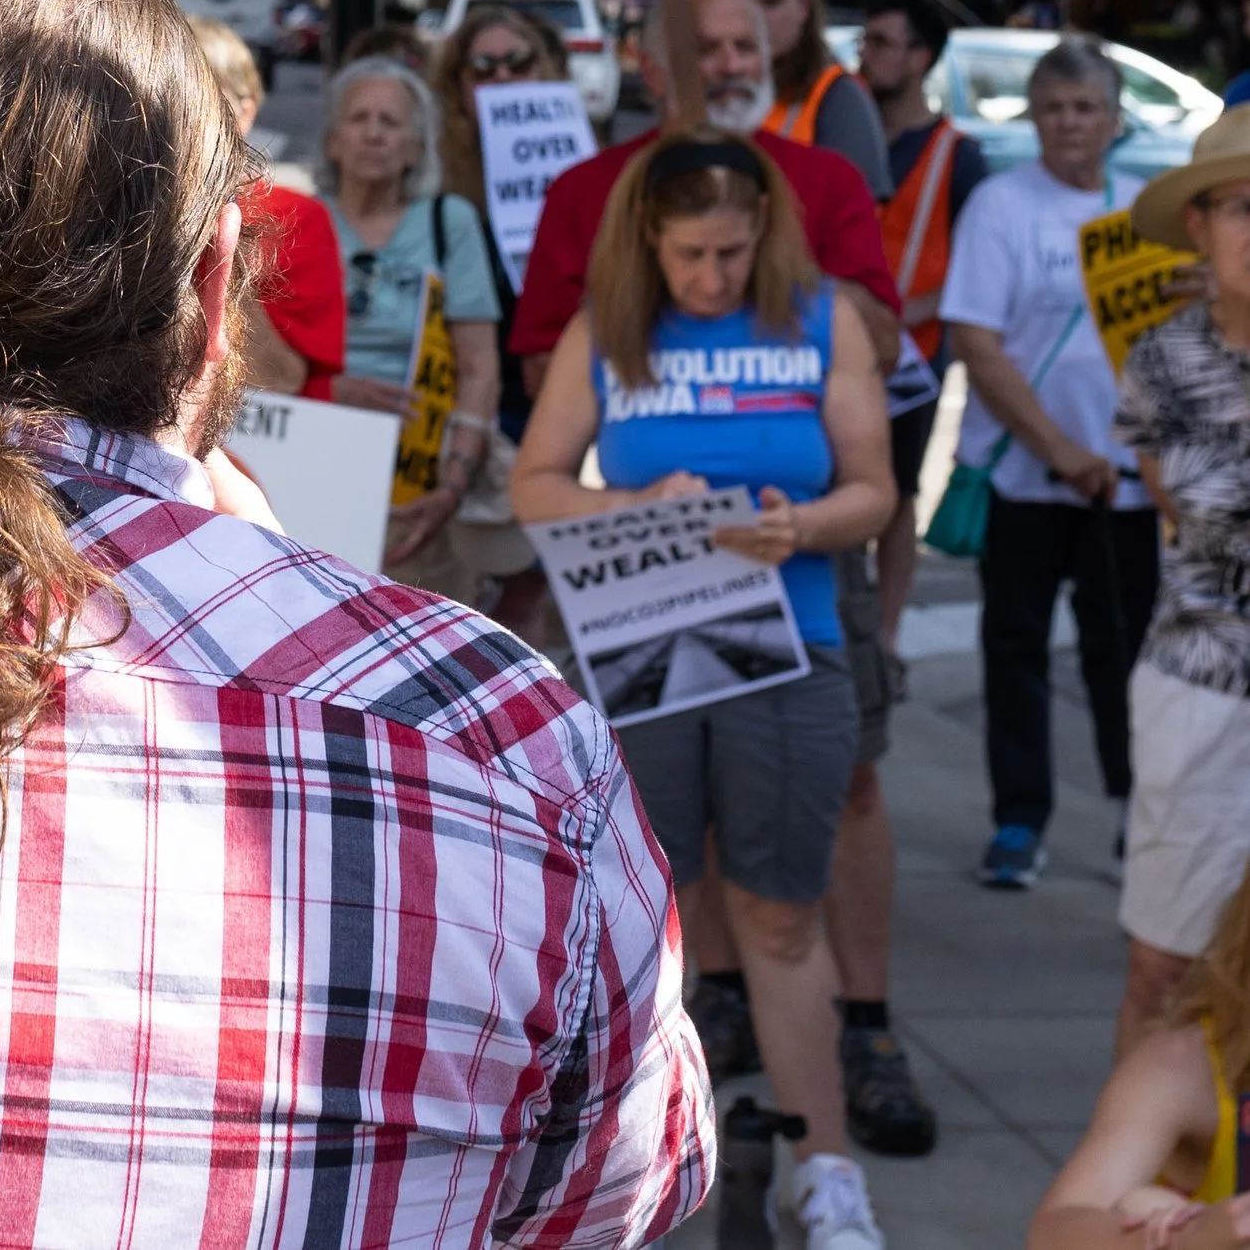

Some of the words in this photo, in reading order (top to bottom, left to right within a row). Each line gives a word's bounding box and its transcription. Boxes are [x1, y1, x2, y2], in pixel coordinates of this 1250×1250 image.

[511, 134, 578, 165] OVER
[549, 497, 734, 539] HEALTH
[588, 518, 710, 549] OVER
[562, 535, 715, 593] WEALT
